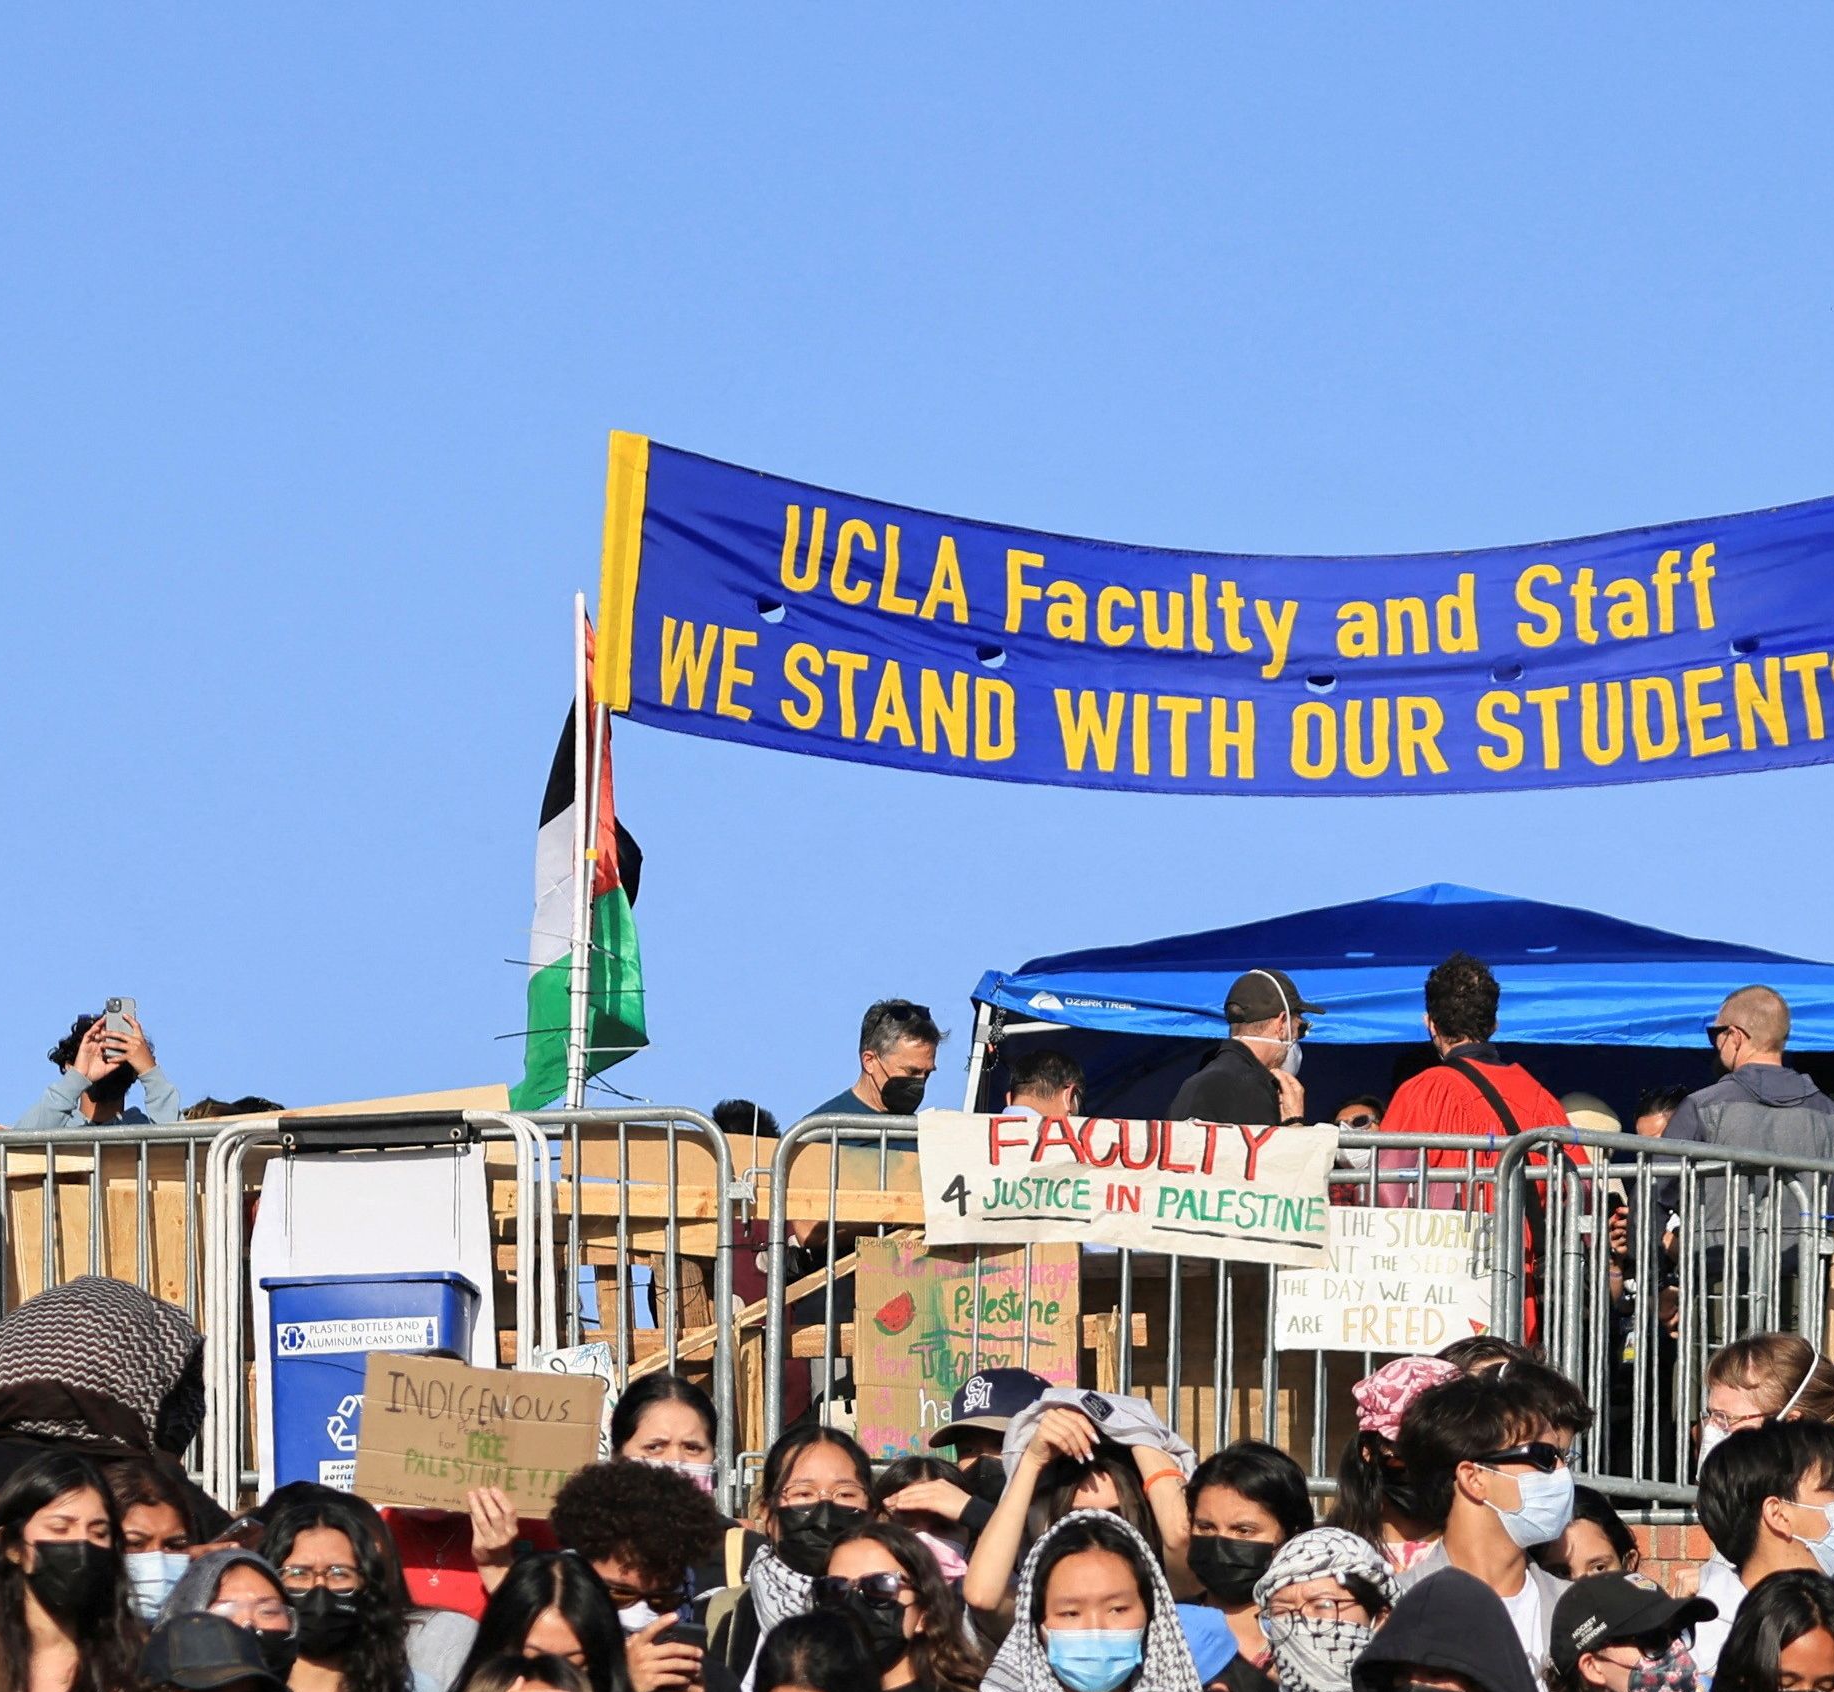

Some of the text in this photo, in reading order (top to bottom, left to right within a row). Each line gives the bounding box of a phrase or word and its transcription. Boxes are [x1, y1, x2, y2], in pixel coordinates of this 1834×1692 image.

[780, 503, 1717, 679] UCLA Faculty and Staff
[661, 615, 757, 722] WE
[779, 642, 1016, 762] STAND
[1054, 687, 1255, 780] WITH
[1290, 695, 1448, 780] OUR
[988, 1115, 1278, 1182] FACULTY
[940, 1173, 1326, 1233] 4 JUSTICE IN PALESTINE
[1341, 1210, 1376, 1237] THE
[1370, 1254, 1398, 1272] THE
[1410, 1253, 1459, 1273] SEED
[954, 1285, 1060, 1325] Palestine
[1281, 1277, 1460, 1304] THE DAY WE ALL
[305, 1333, 425, 1348] ALUMINUM CANS ONLY
[309, 1320, 420, 1335] PLASTIC BOTTLES AND
[1286, 1304, 1446, 1346] ARE FREED
[385, 1371, 571, 1426] INDIGENOUS
[1571, 1615, 1597, 1640] HOCKEY
[1575, 1621, 1608, 1650] EVERYONE
